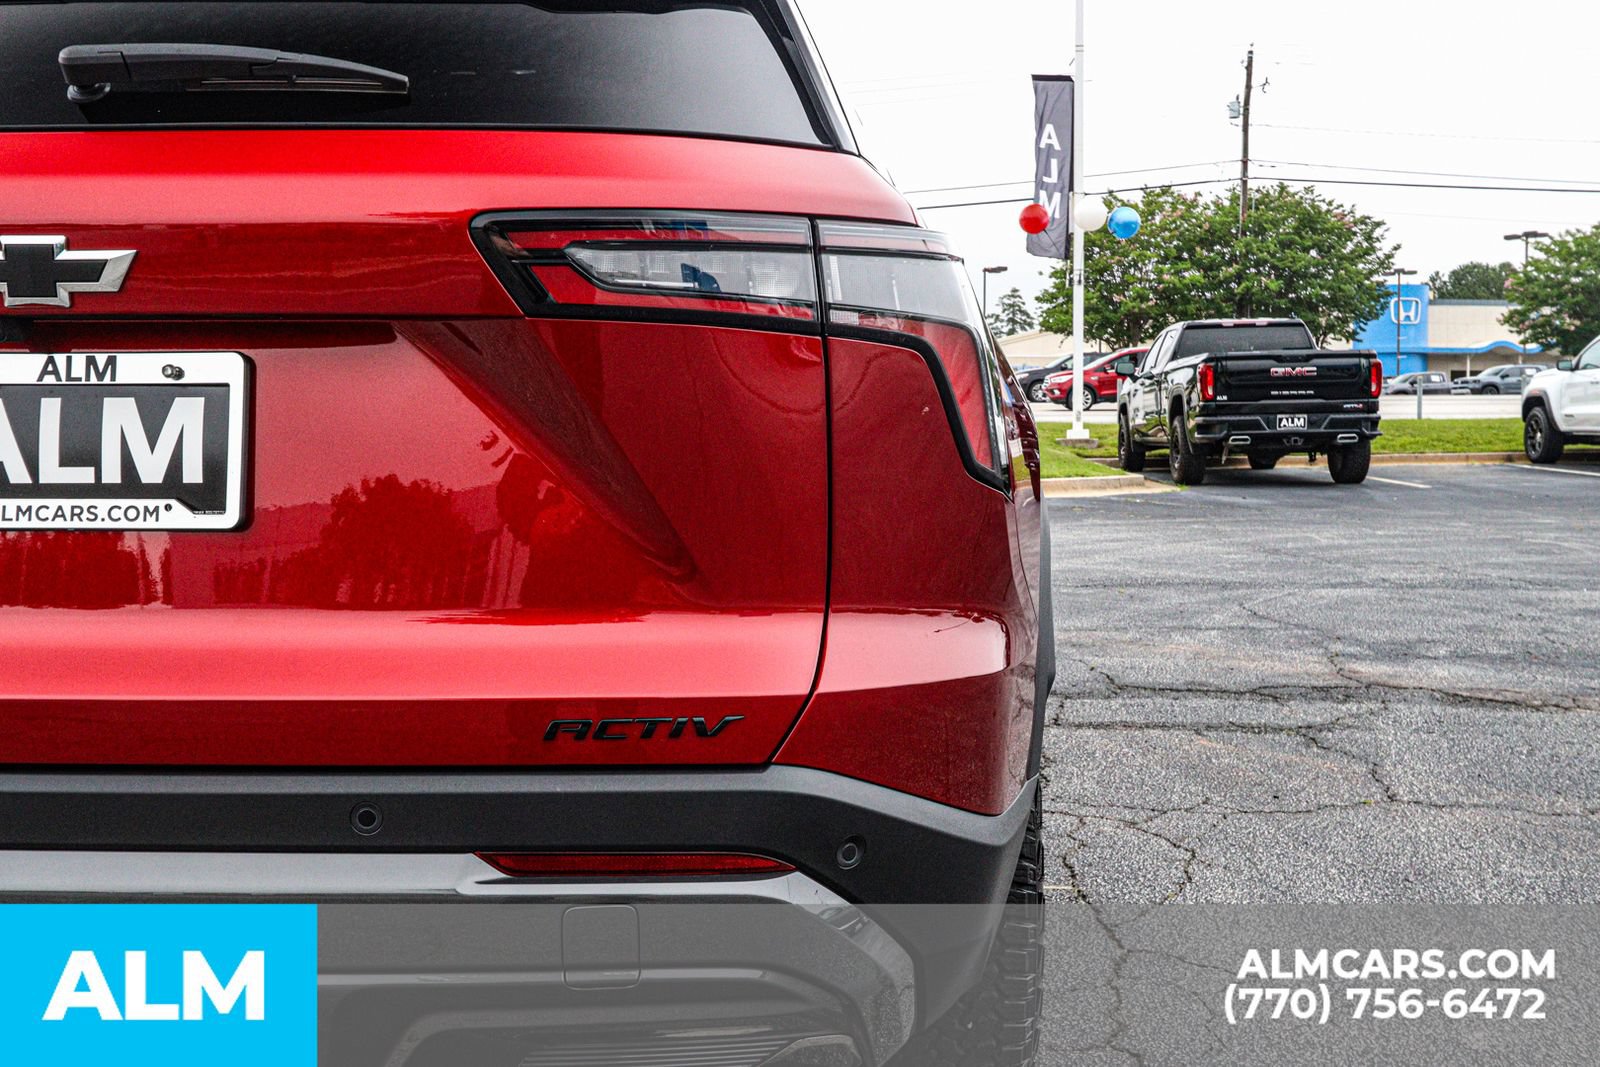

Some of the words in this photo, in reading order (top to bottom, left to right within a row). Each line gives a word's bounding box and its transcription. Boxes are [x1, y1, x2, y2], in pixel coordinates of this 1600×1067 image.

[36, 355, 117, 382] ALM
[1270, 367, 1317, 377] GMC
[1280, 417, 1304, 427] ALM
[1, 505, 160, 522] LMCARS.COM
[543, 715, 744, 741] ACTIV
